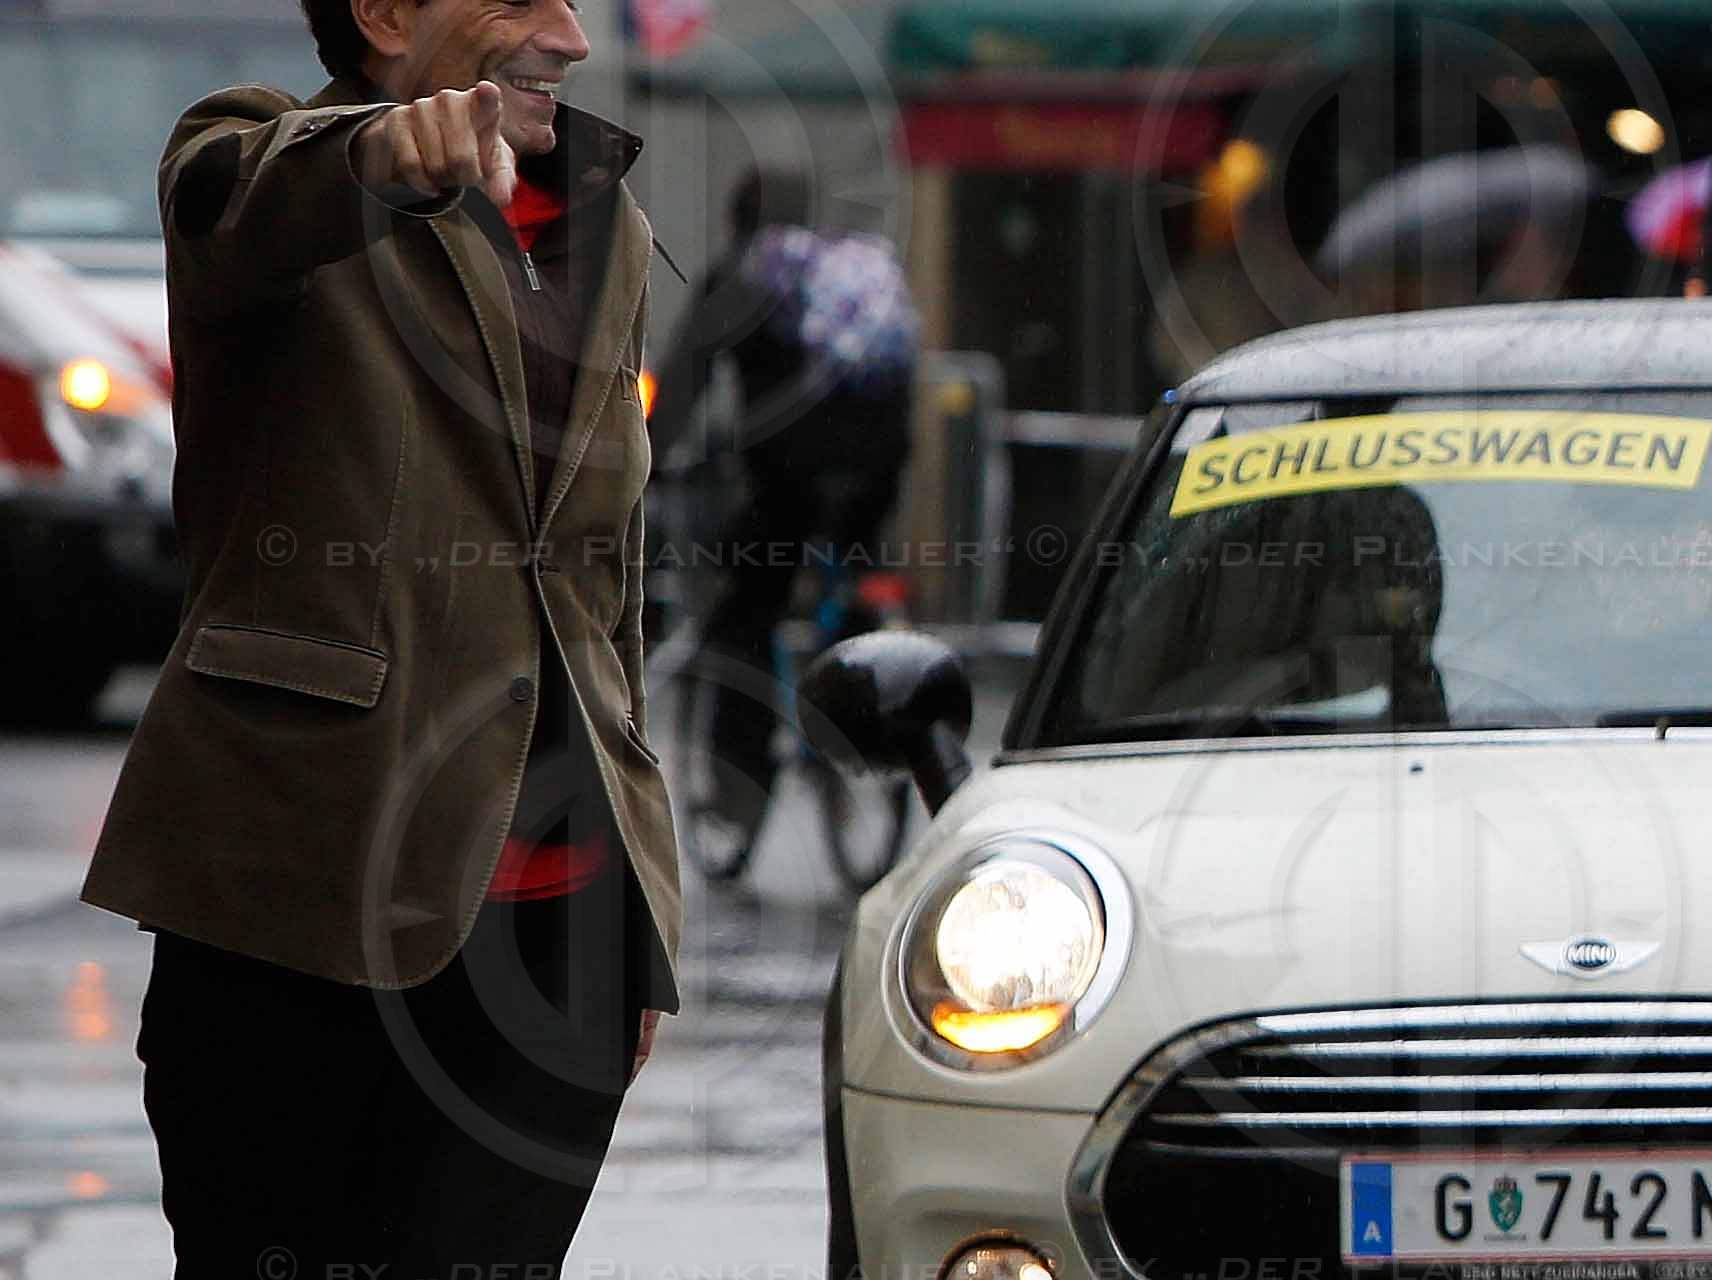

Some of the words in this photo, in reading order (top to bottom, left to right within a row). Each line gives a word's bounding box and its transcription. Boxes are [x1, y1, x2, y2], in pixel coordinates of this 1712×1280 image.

[1192, 427, 1690, 496] SCHLUSSWAGEN
[1567, 943, 1613, 963] MINI
[1433, 1171, 1474, 1243] G
[1361, 1221, 1382, 1243] A
